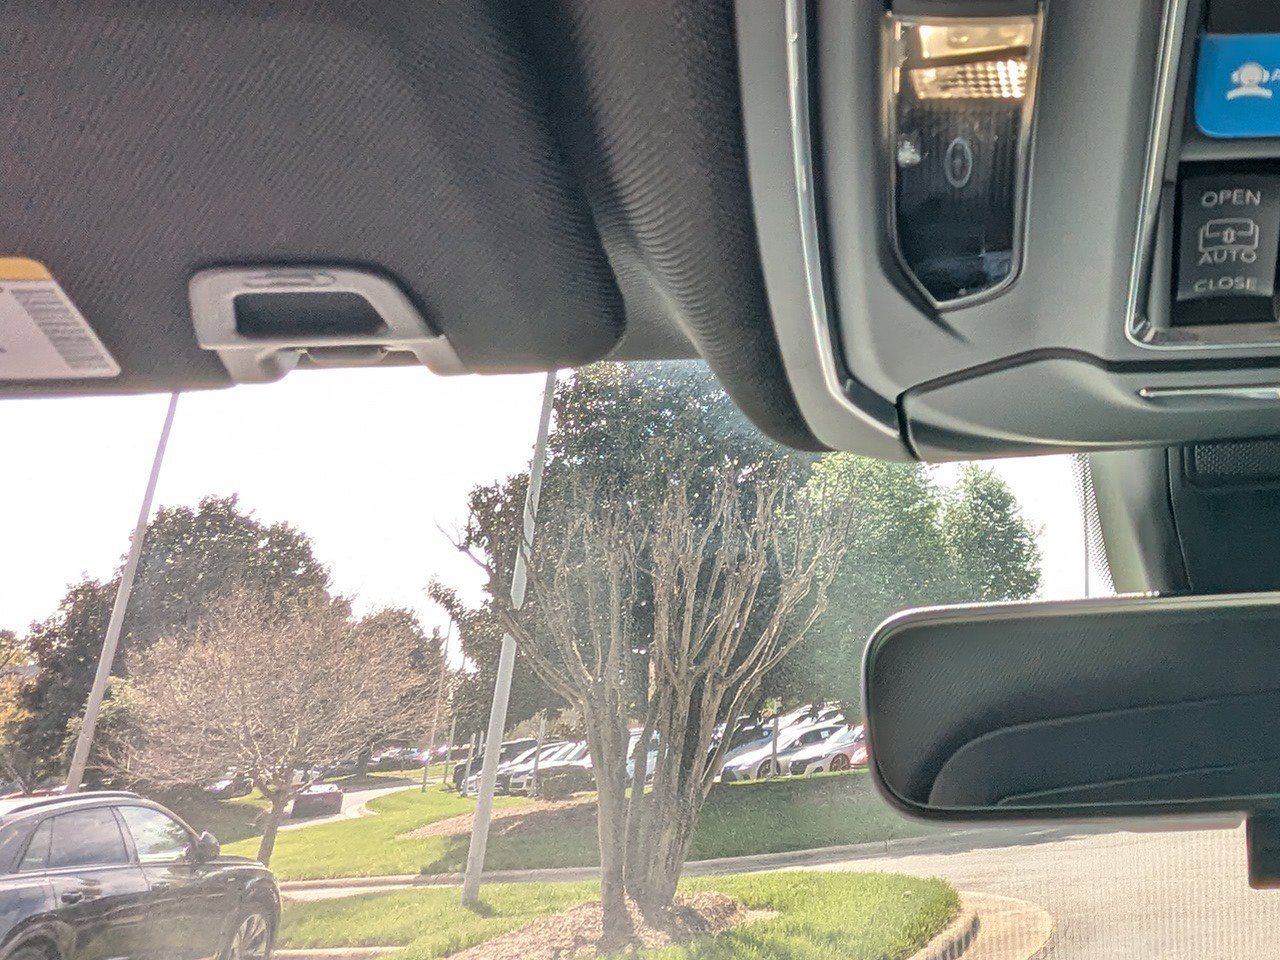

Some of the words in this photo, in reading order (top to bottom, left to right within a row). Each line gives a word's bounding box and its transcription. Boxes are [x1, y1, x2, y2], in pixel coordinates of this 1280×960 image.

[1201, 189, 1261, 208] OPEN
[1197, 248, 1258, 266] AUTO
[1194, 276, 1258, 292] CLOSE
